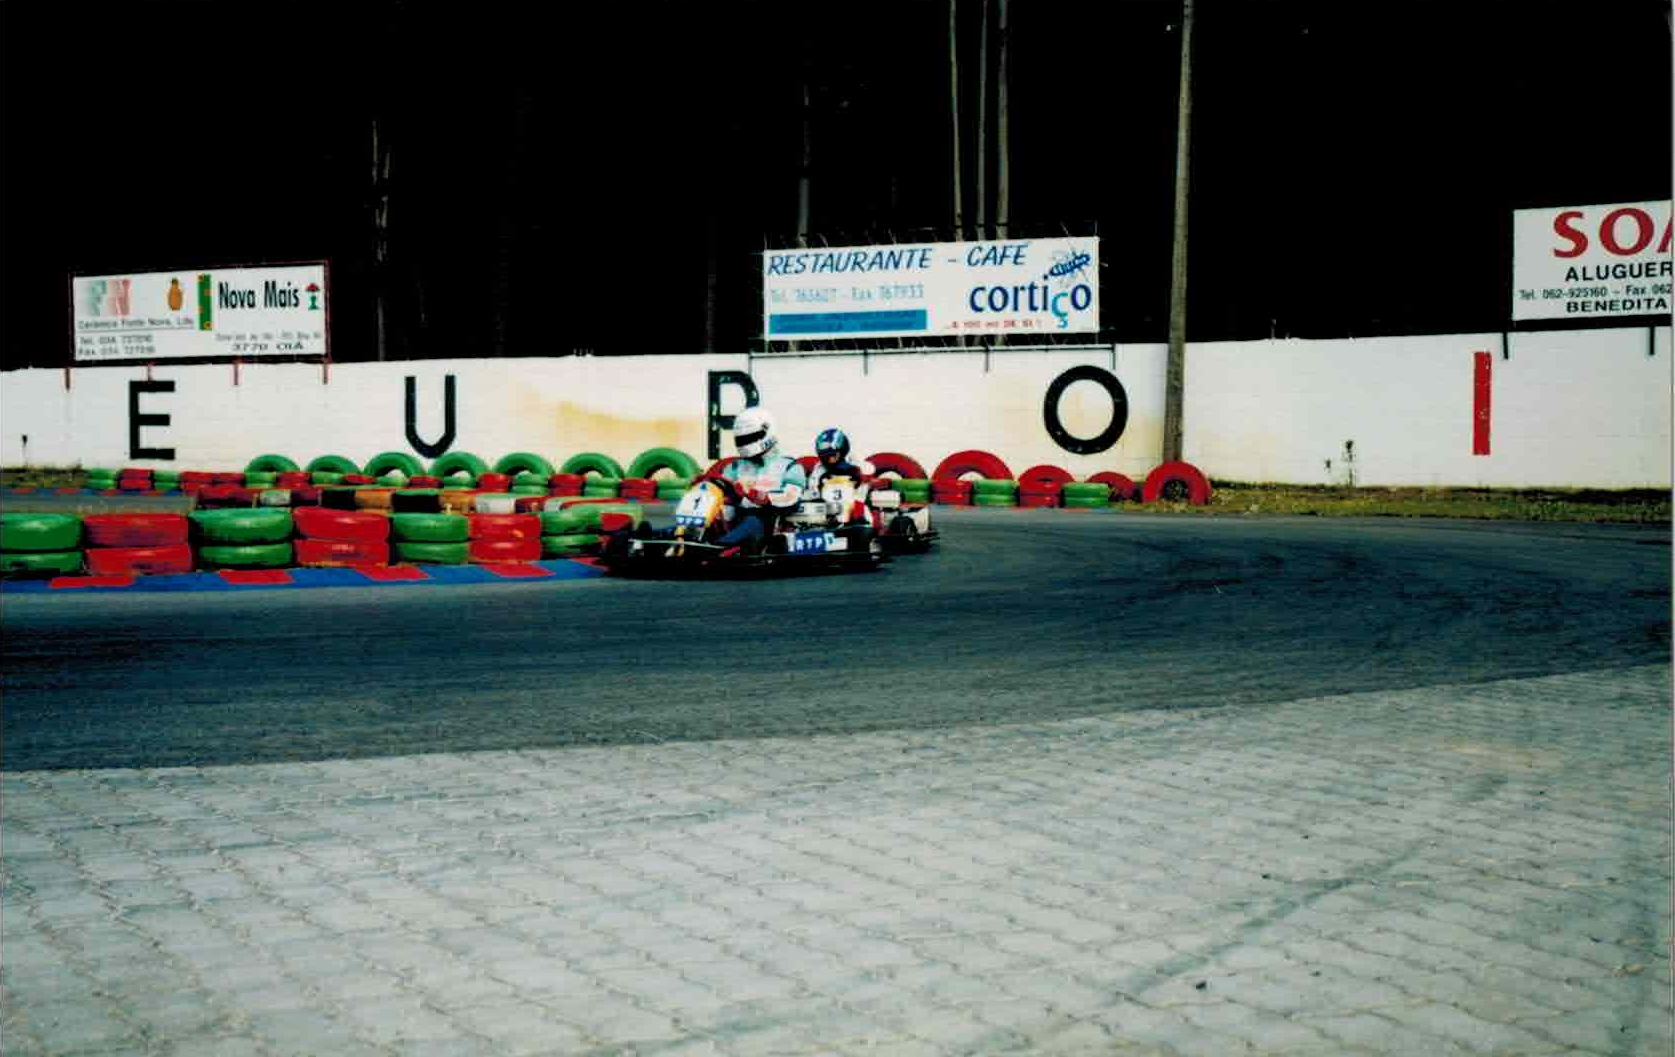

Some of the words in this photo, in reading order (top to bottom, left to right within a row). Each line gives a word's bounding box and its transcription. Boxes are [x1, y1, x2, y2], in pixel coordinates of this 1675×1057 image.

[767, 248, 932, 275] RESTAURANTE
[219, 281, 256, 309] Nova
[264, 280, 300, 308] Mais
[969, 274, 1092, 329] cortiço
[1626, 284, 1646, 295] Fax
[1566, 298, 1668, 313] BENEDITA
[129, 380, 175, 460] E
[404, 374, 456, 459] U
[1044, 365, 1128, 455] O
